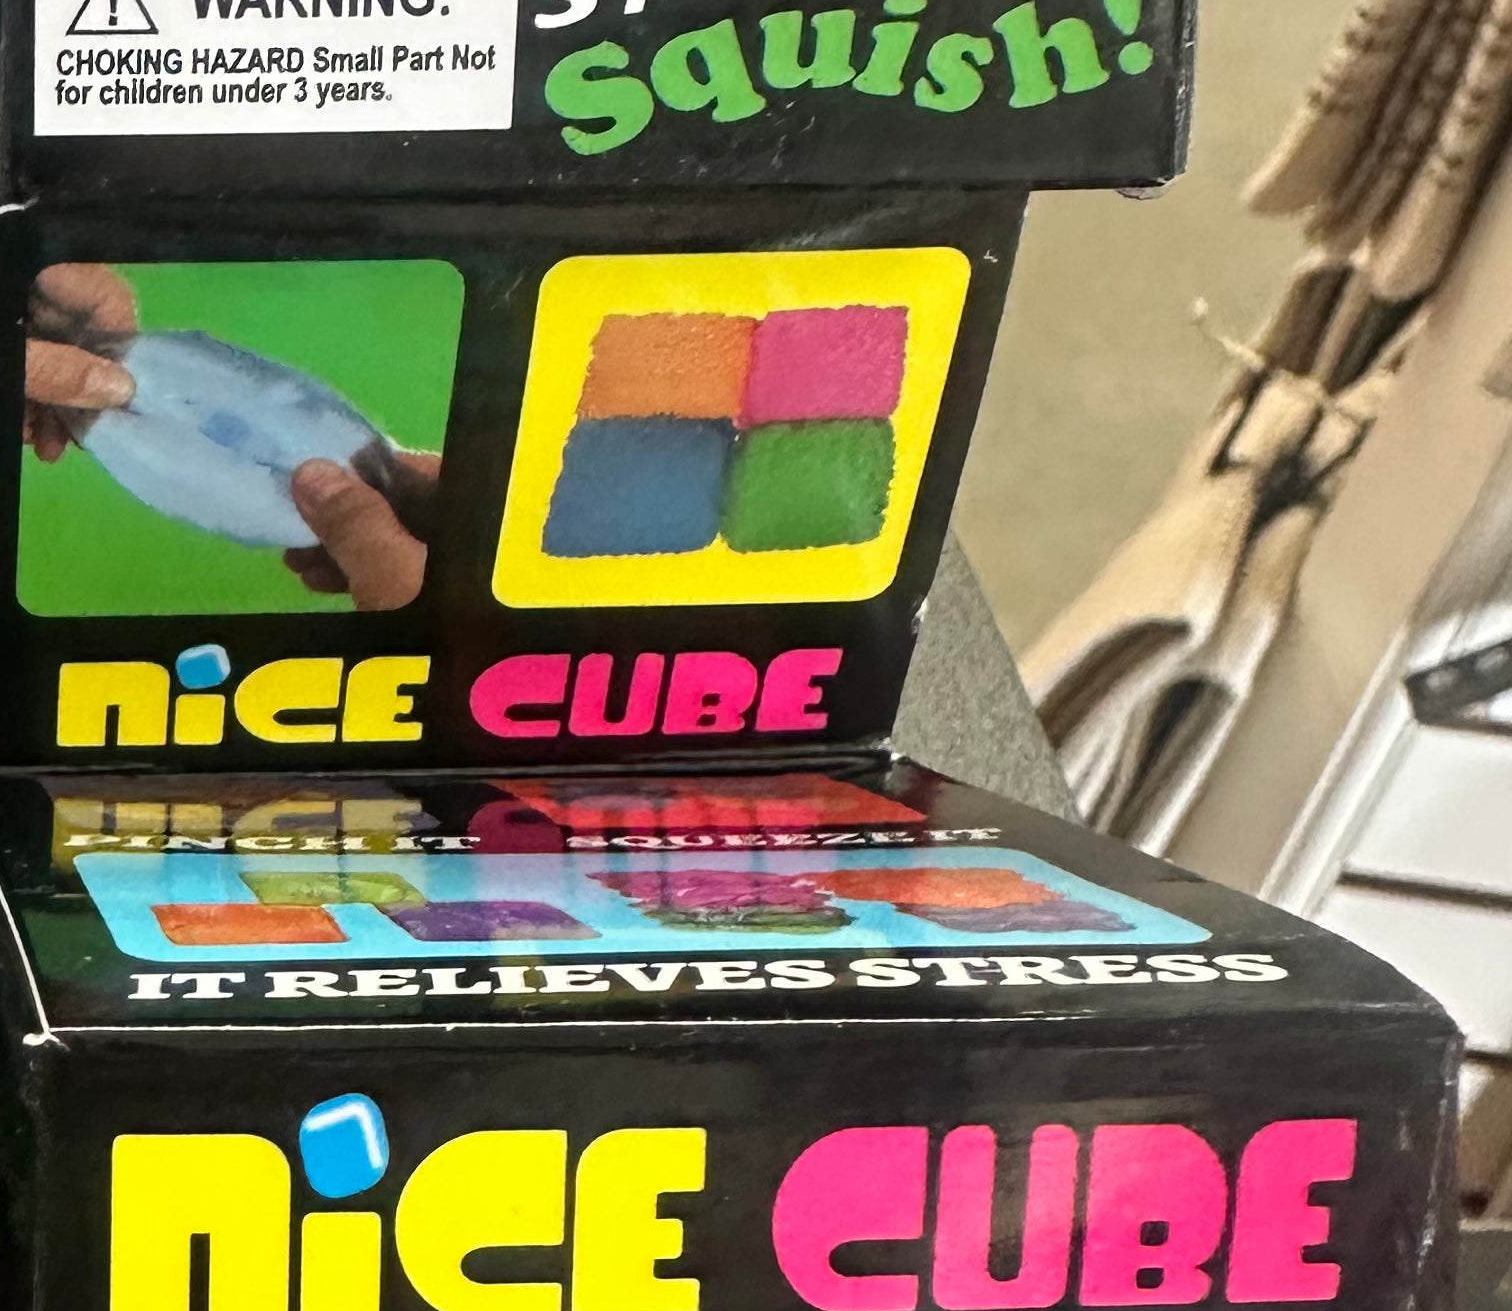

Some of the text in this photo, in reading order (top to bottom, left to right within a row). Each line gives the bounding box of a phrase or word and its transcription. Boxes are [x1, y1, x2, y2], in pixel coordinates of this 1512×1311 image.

[56, 44, 496, 76] CHOKING HAZARD Small Part Not
[55, 77, 393, 109] for children under 3 years.
[469, 648, 844, 738] CUBE
[127, 953, 1289, 1000] IT RELIEVES STRESS
